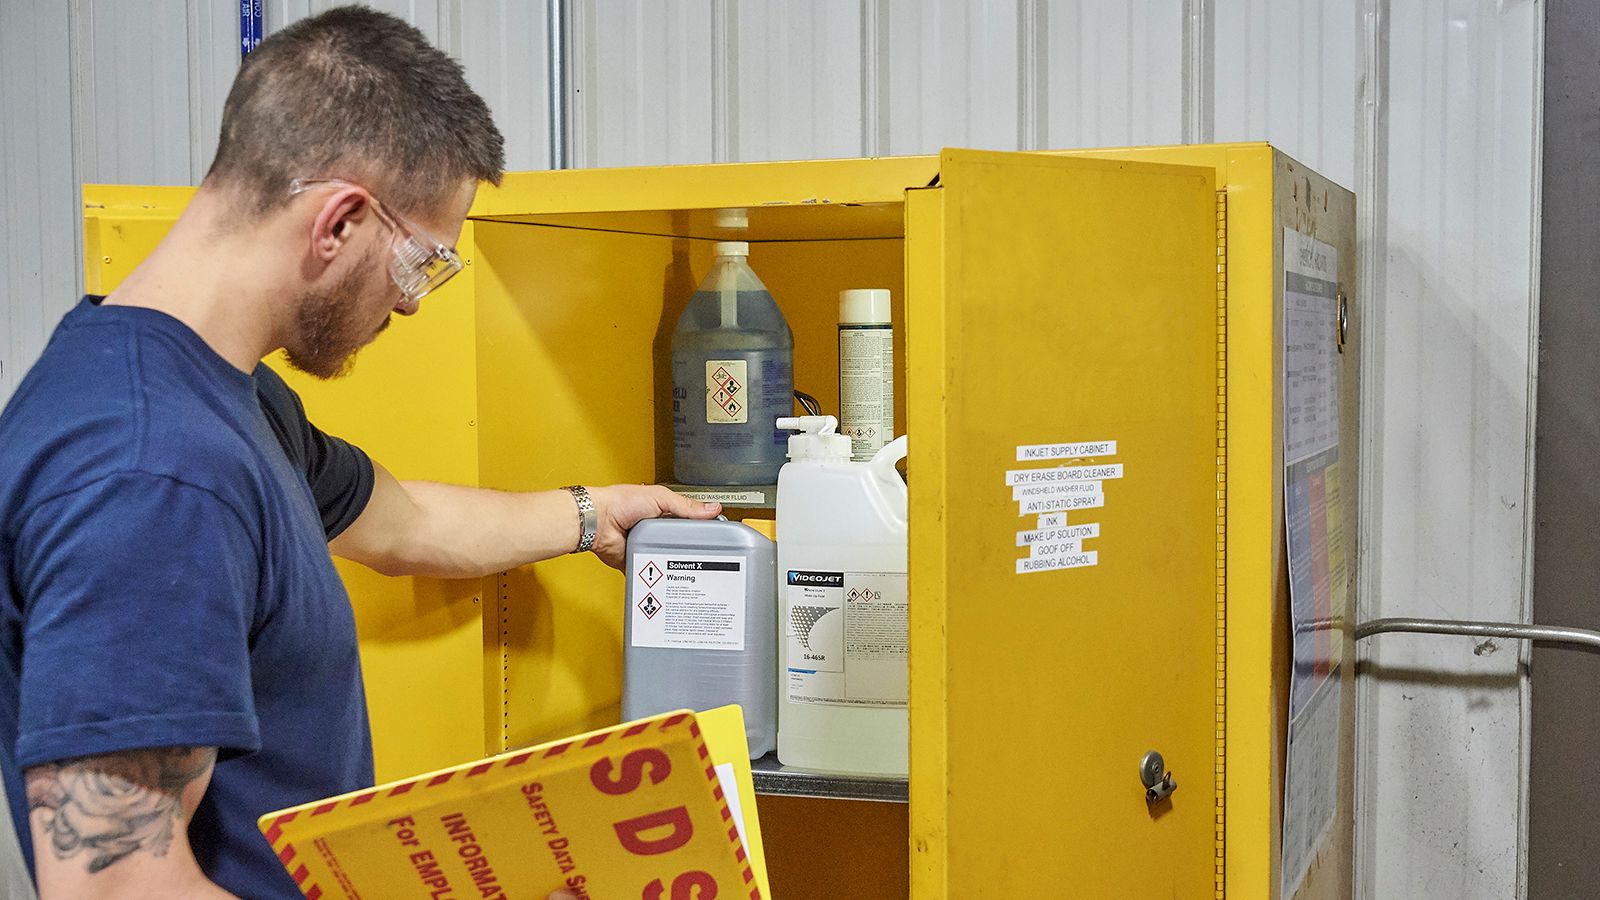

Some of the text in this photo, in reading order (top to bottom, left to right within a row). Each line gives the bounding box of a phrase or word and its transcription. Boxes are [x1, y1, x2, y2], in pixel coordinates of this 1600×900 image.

[1025, 444, 1109, 458] INKJET SUPPLY CABINET
[1014, 468, 1116, 483] DRY ERASE BOARD CLEANER
[1022, 484, 1094, 496] WINDSHIELD WASHER FLUID
[707, 493, 730, 501] WASHER
[1027, 497, 1096, 511] ANTI-STATIC SPRAY
[1046, 517, 1058, 525] INK
[1023, 527, 1092, 543] MAKE UP SOLUTION
[1038, 543, 1074, 555] GOOF OFF
[669, 562, 703, 570] Solvent X
[1023, 555, 1090, 570] RUBBING ALCOHOL
[667, 574, 696, 583] Warning
[794, 573, 842, 583] VIDEOJET
[386, 815, 420, 847] For
[521, 782, 559, 836] SAFETY
[548, 837, 575, 874] DATA
